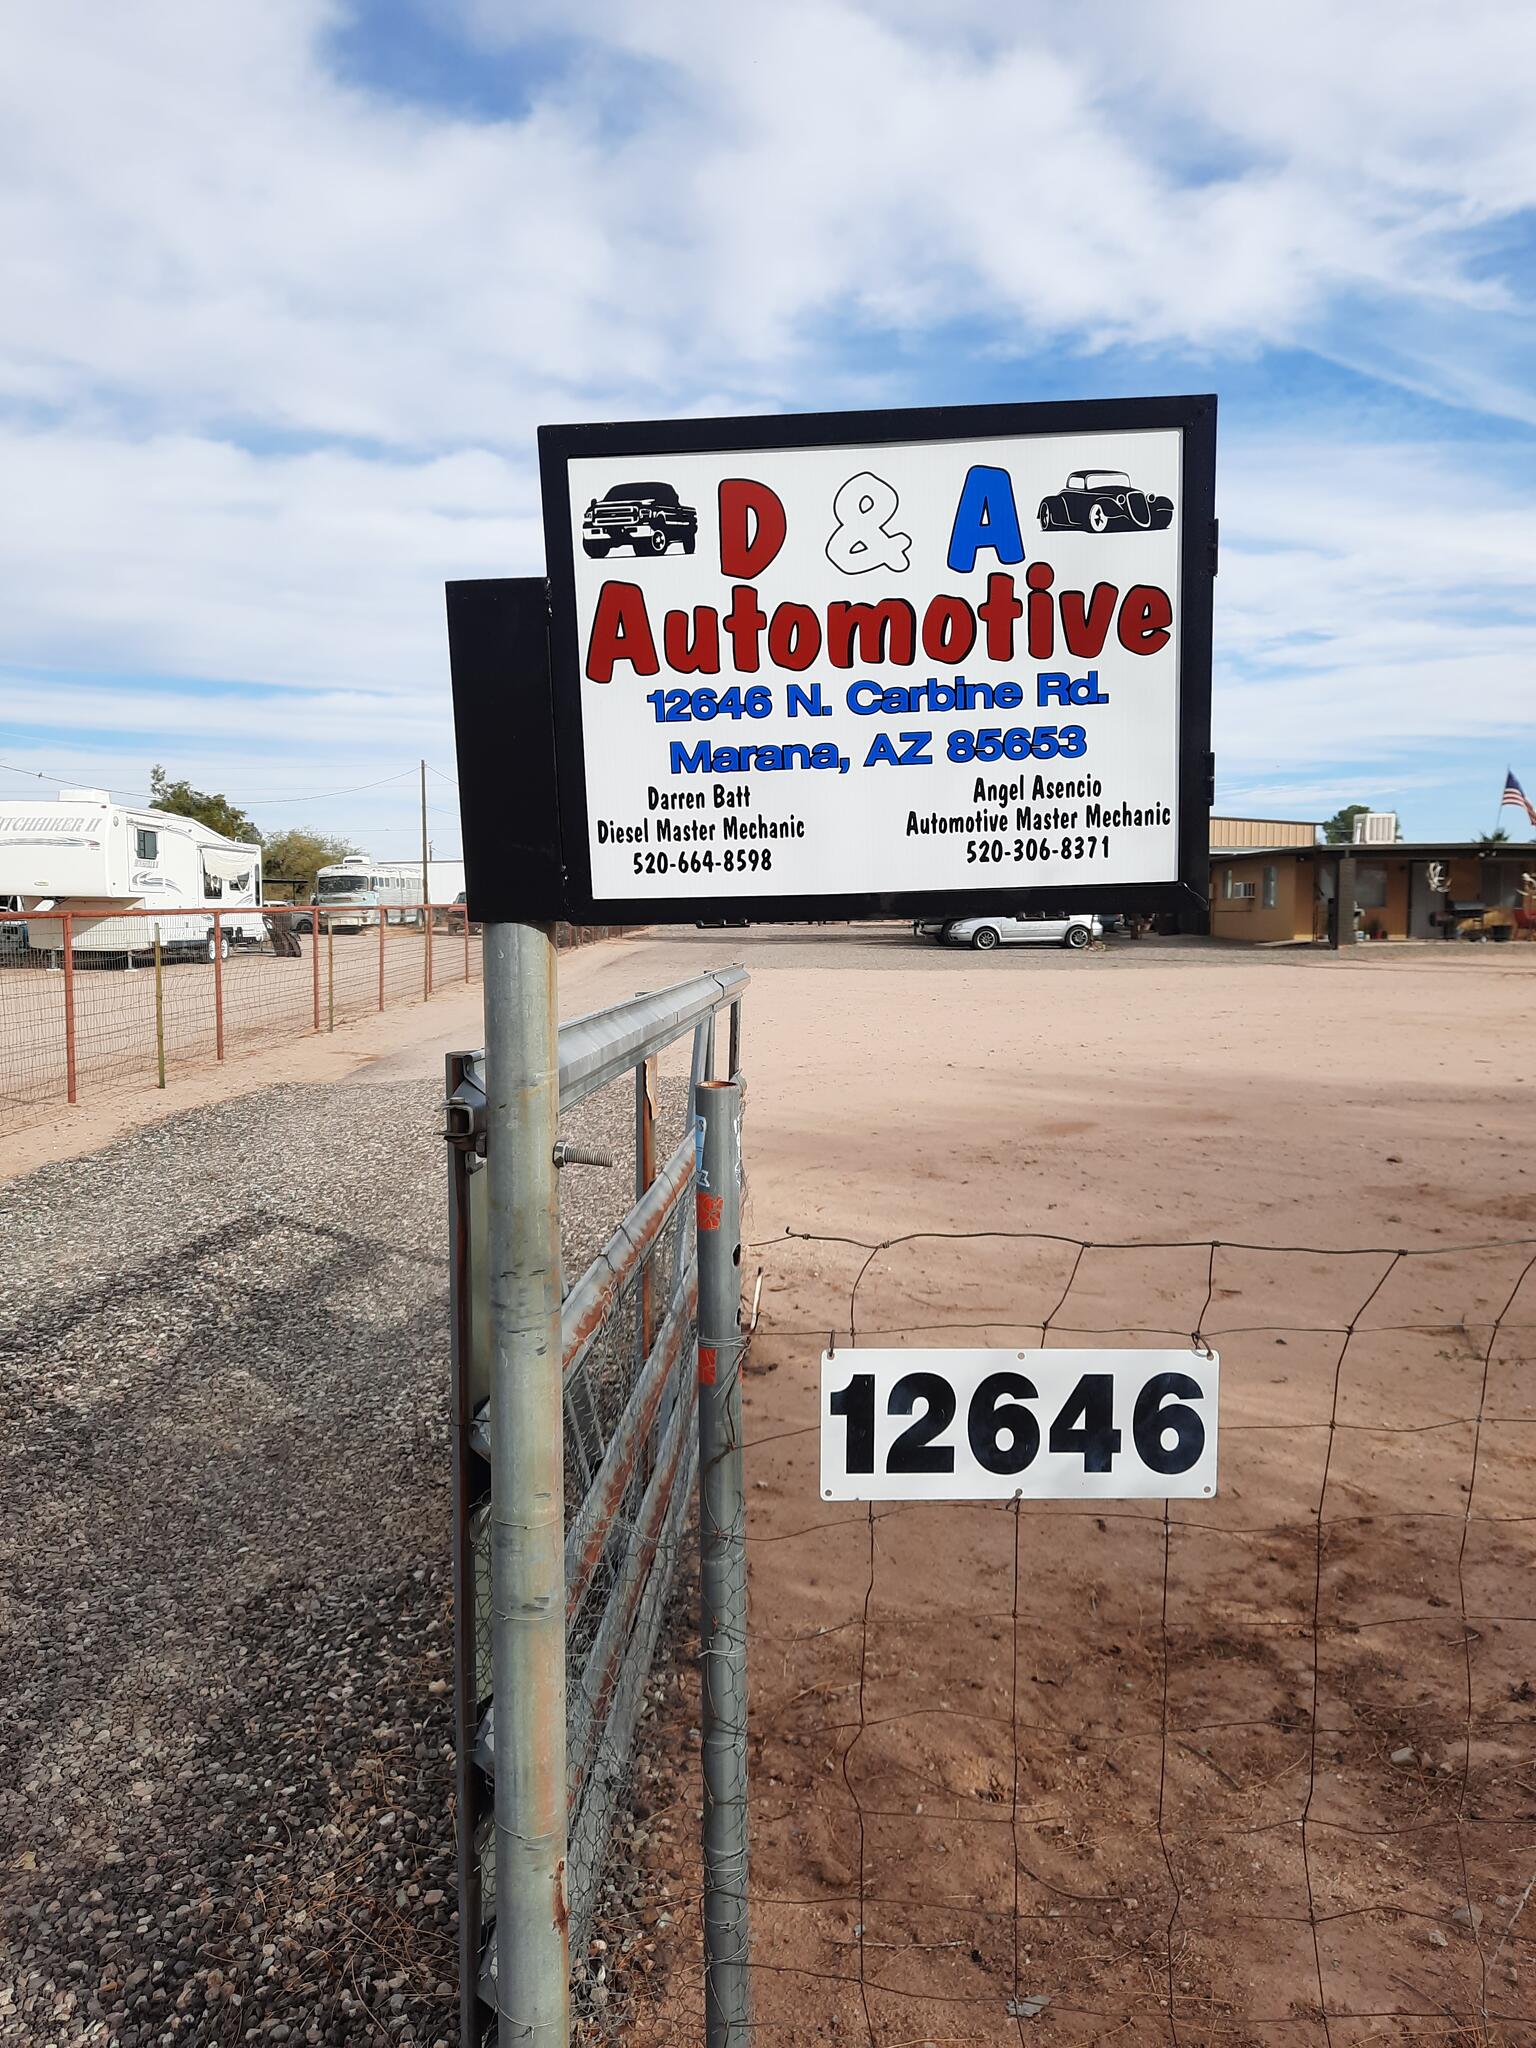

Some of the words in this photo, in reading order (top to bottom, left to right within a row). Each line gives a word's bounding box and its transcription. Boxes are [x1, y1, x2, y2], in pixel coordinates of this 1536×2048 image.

[718, 478, 787, 580] D
[825, 471, 912, 575] &
[946, 465, 1026, 573] A
[585, 562, 1173, 683] Automotive
[647, 685, 773, 722] 12646
[786, 683, 832, 717] N.
[846, 676, 1023, 715] Carbine
[1036, 671, 1109, 706] Rd.
[670, 740, 850, 774] Marana,
[863, 731, 933, 767] AZ
[947, 725, 1087, 763] 85653
[647, 786, 705, 810] Darren
[713, 784, 750, 808] Batt
[973, 774, 1024, 808] Angel
[1032, 773, 1101, 801] Asencio
[0, 816, 84, 832] ITCHHIKER
[597, 817, 649, 844] Diesel
[656, 818, 716, 842] Master
[723, 814, 805, 840] Mechanic
[906, 808, 1008, 836] Automotive
[1016, 806, 1078, 831] Master
[1086, 801, 1171, 828] Mechanic
[633, 849, 772, 874] 520-664-8598
[966, 835, 1110, 863] 520-306-8371
[829, 1372, 1205, 1475] 12646
